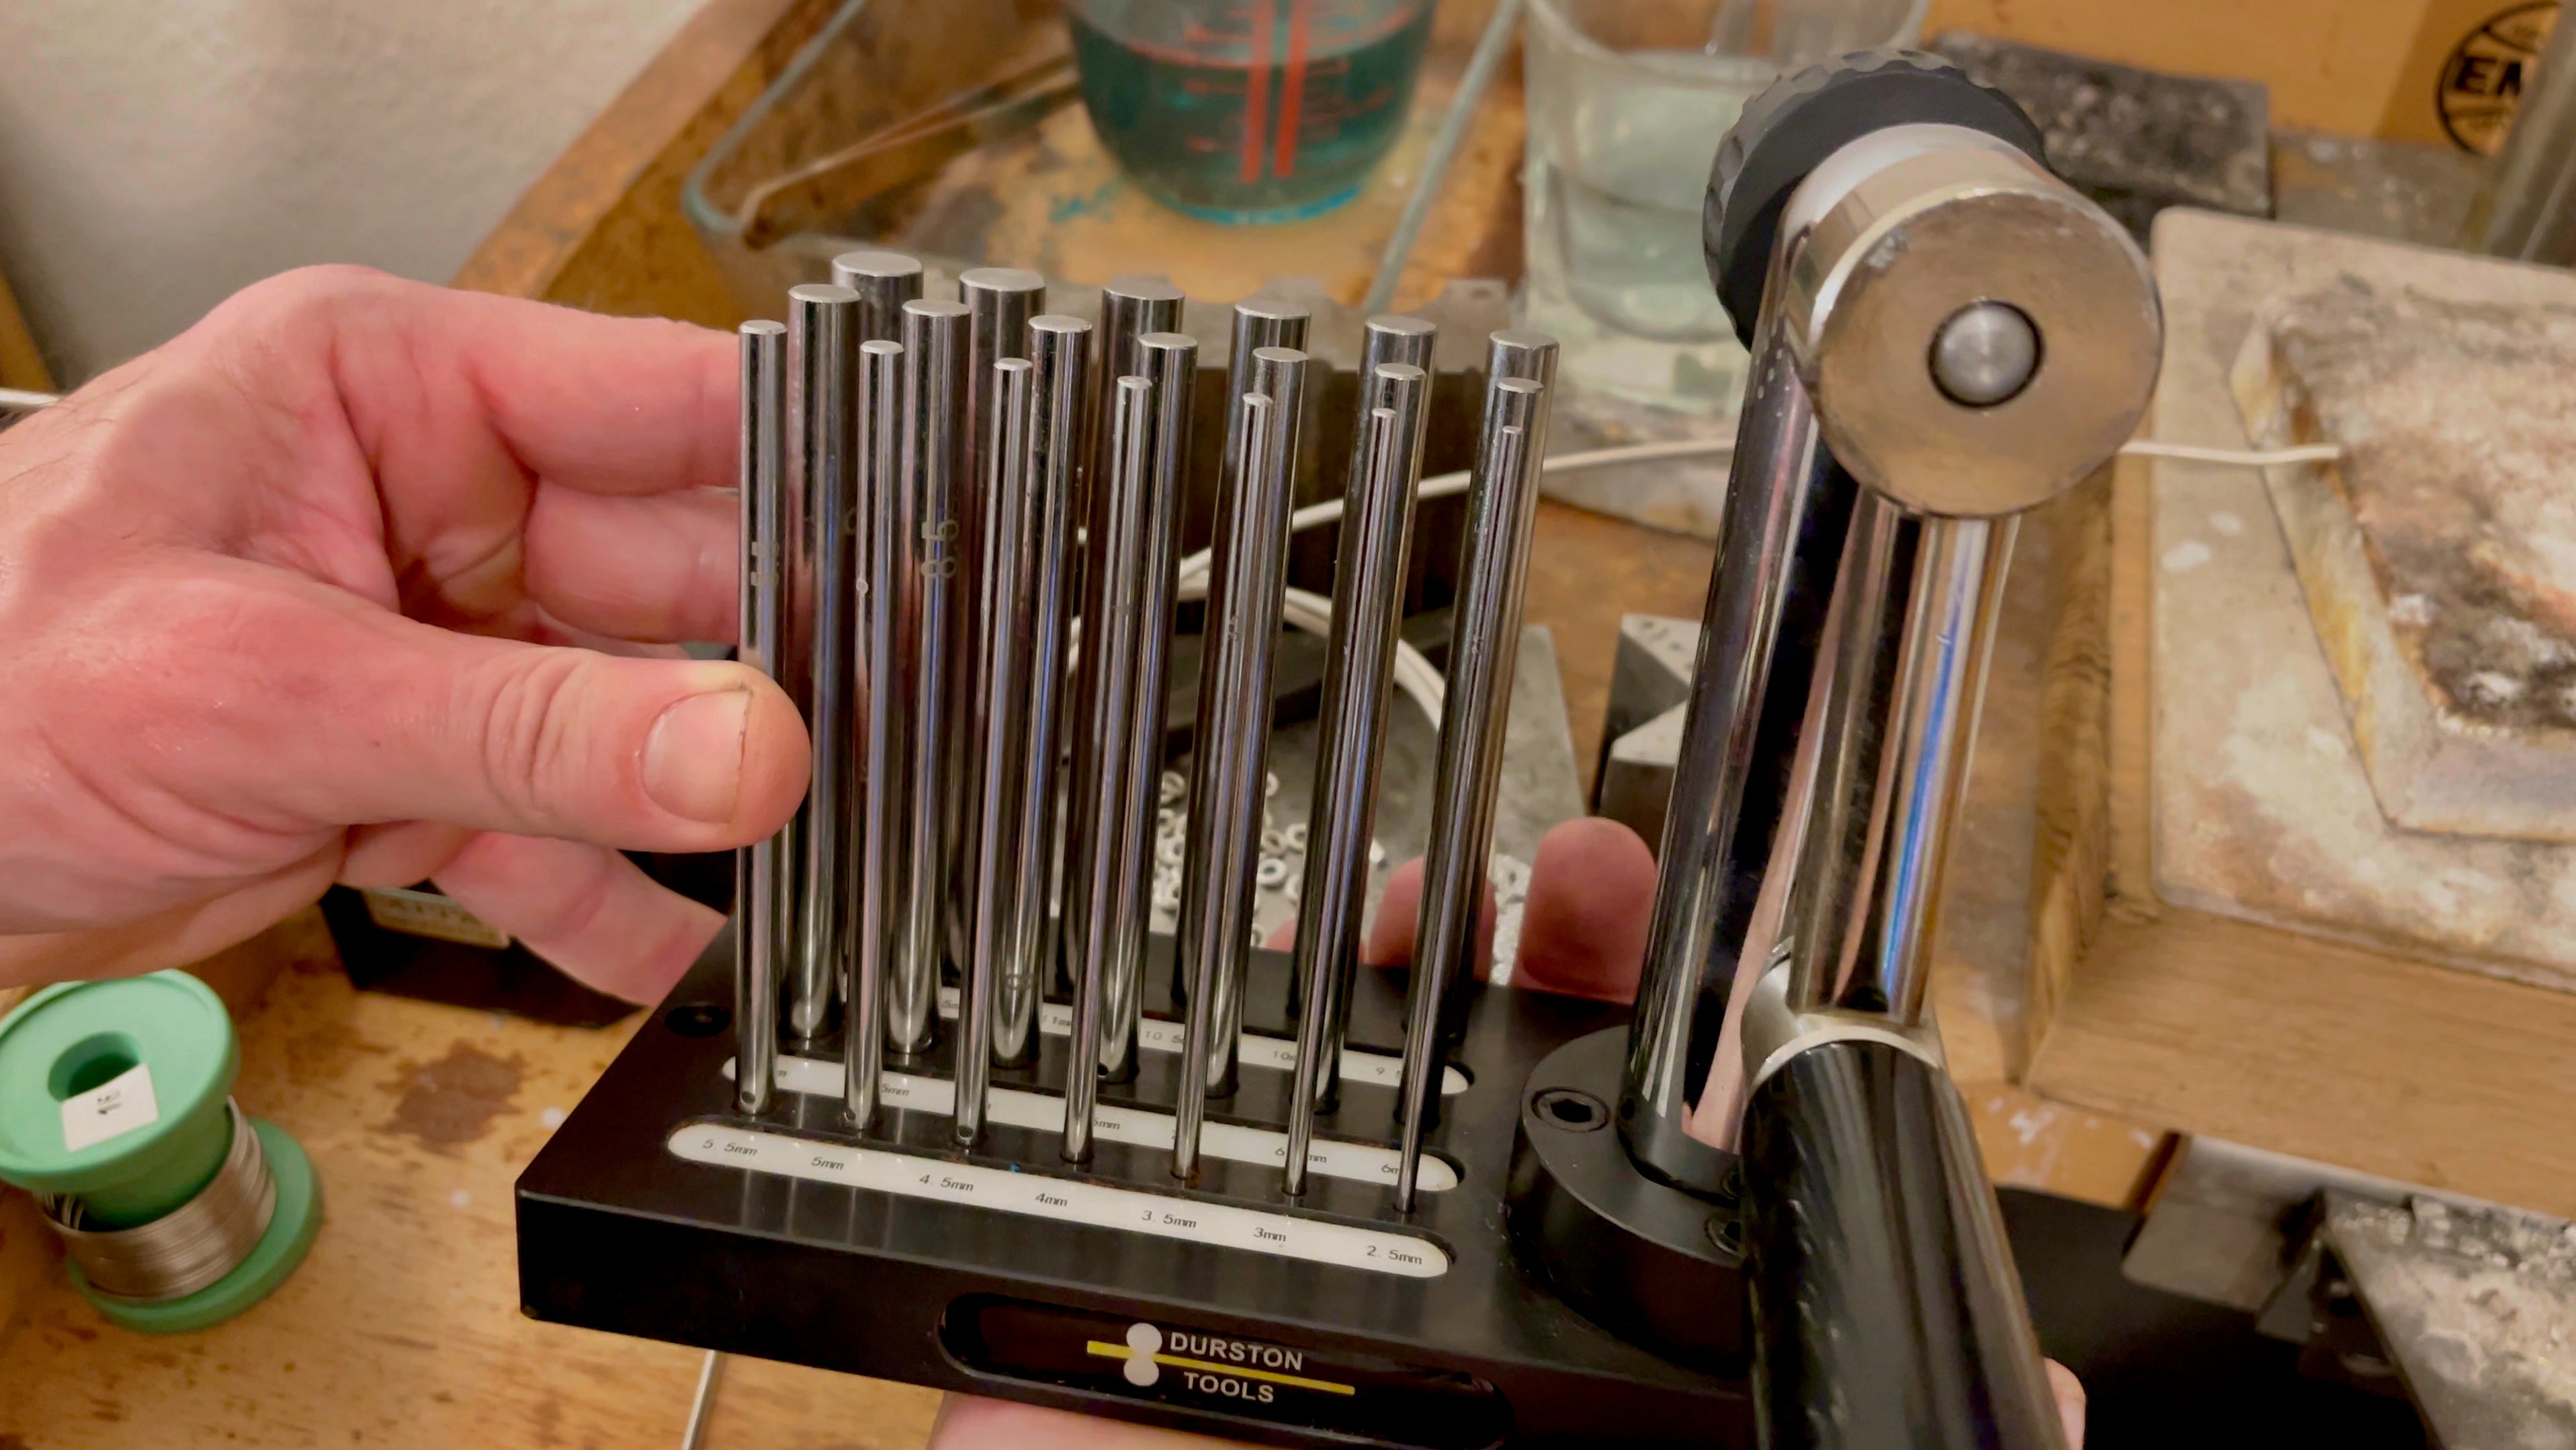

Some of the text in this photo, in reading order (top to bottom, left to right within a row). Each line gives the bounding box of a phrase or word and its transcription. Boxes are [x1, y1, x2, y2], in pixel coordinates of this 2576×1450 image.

[811, 1156, 845, 1171] 5mm
[1035, 1192, 1068, 1207] 4mm
[1252, 1226, 1287, 1243] 3mm
[1170, 1331, 1303, 1371] DURSTON
[1183, 1371, 1275, 1404] TOOLS
